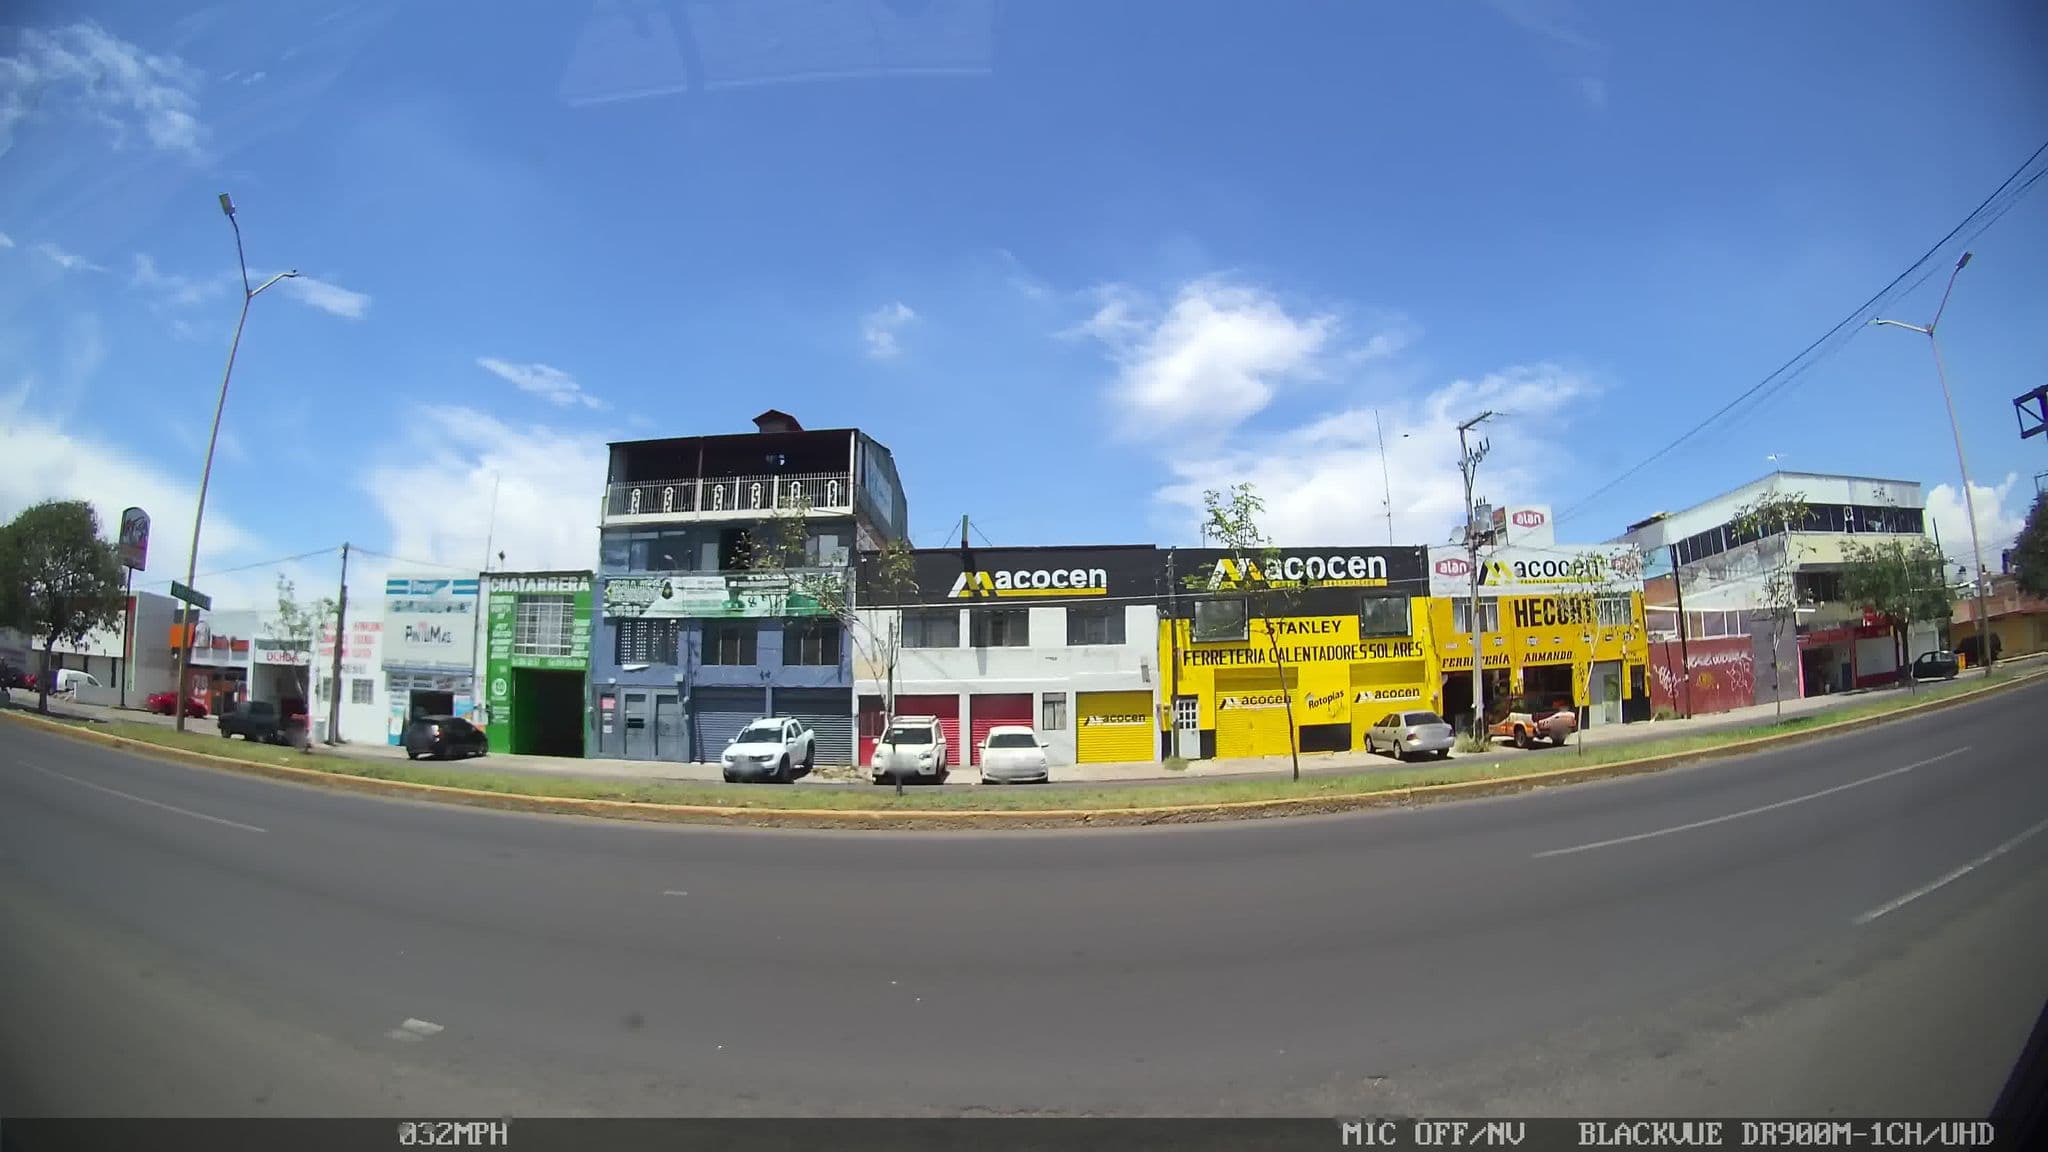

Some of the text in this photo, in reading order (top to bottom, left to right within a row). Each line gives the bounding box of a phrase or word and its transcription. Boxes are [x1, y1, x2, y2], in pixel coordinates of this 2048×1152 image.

[1516, 511, 1541, 525] alan
[1440, 560, 1467, 574] alan
[490, 576, 590, 592] CHATARRERA
[1267, 620, 1341, 635] STANLEY
[1183, 641, 1424, 666] FERRETERIA CALENTADORES SOLARES
[1442, 650, 1573, 668] FERRERÍA ARMANDO
[1308, 690, 1344, 709] Rotoplas
